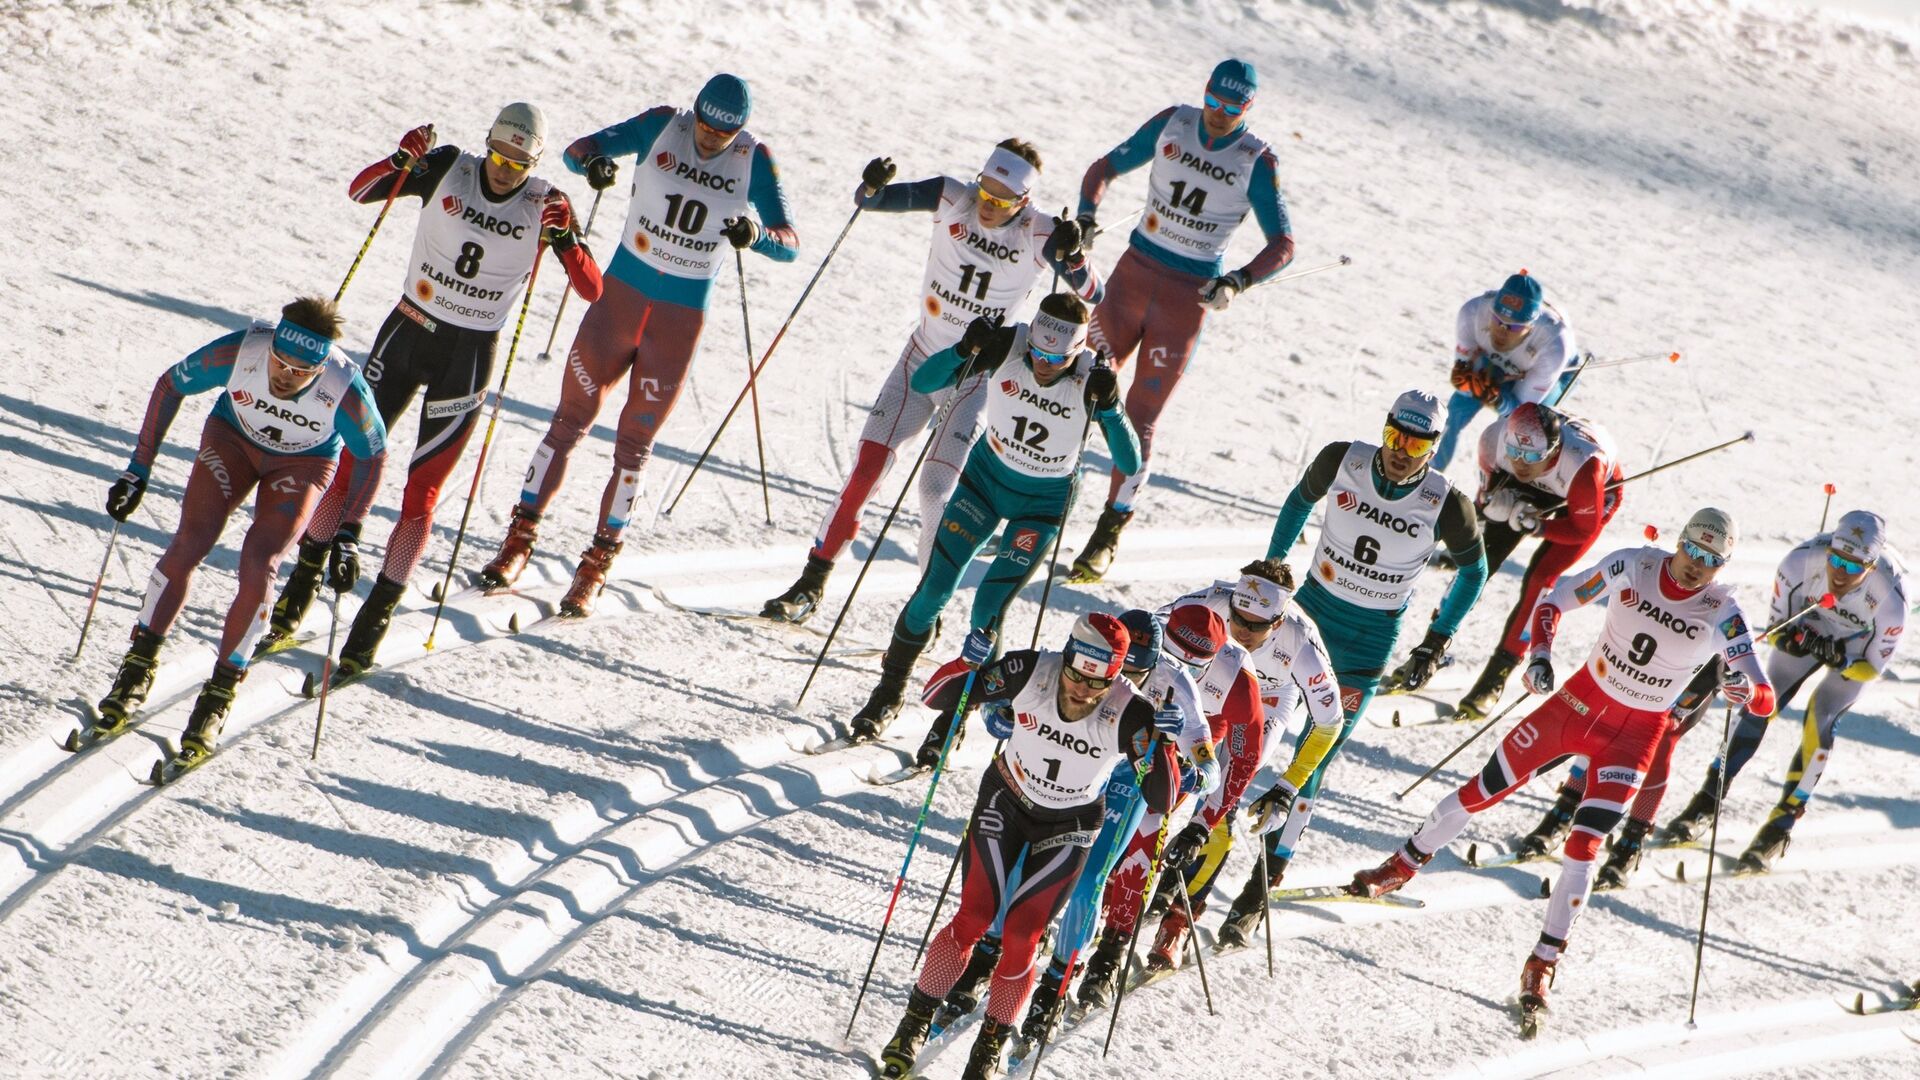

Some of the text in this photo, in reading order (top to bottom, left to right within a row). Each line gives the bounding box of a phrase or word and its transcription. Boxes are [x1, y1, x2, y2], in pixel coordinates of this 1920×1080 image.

[1220, 76, 1256, 102] LUKO
[702, 100, 743, 125] LUKOIL
[675, 162, 737, 194] PAROC
[1180, 152, 1237, 186] PAROC
[665, 193, 708, 235] 10
[1169, 180, 1208, 217] 14
[462, 206, 525, 240] PAROC
[1152, 199, 1218, 233] #LAHTI2017
[639, 215, 718, 253] #LAHTI2017
[966, 232, 1019, 263] PAROC
[1160, 225, 1211, 250] storaenso
[455, 241, 485, 279] 8
[651, 246, 710, 269] storaenso
[420, 261, 504, 302] #LAHTI2017
[958, 264, 992, 301] 11
[434, 295, 496, 320] storaenso
[930, 280, 1007, 319] #LAHTI2017
[942, 311, 969, 329] stora
[280, 326, 326, 355] LUKOIL
[570, 349, 599, 397] LUKOIL
[254, 398, 321, 433] PAROC
[428, 397, 478, 416] SpareBank
[1019, 389, 1071, 419] PAROC
[259, 425, 283, 443] 4
[991, 425, 1067, 463] #LAHTI2017
[1011, 415, 1049, 453] 12
[1005, 453, 1065, 473] storaenso
[1356, 502, 1420, 538] PAROC
[1323, 546, 1404, 584] #LAHTI2017
[1353, 535, 1381, 565] 6
[1336, 576, 1398, 600] storaenso
[1637, 599, 1699, 640] PAROC
[1072, 641, 1108, 661] SpareBank
[1601, 642, 1673, 689] #LAHTI2017
[1627, 632, 1657, 666] 9
[1608, 675, 1664, 703] storaenso
[1037, 723, 1102, 759] PAROC
[1042, 757, 1062, 782] 1
[1599, 770, 1643, 786] SpareB
[1032, 832, 1093, 853] SpareBank
